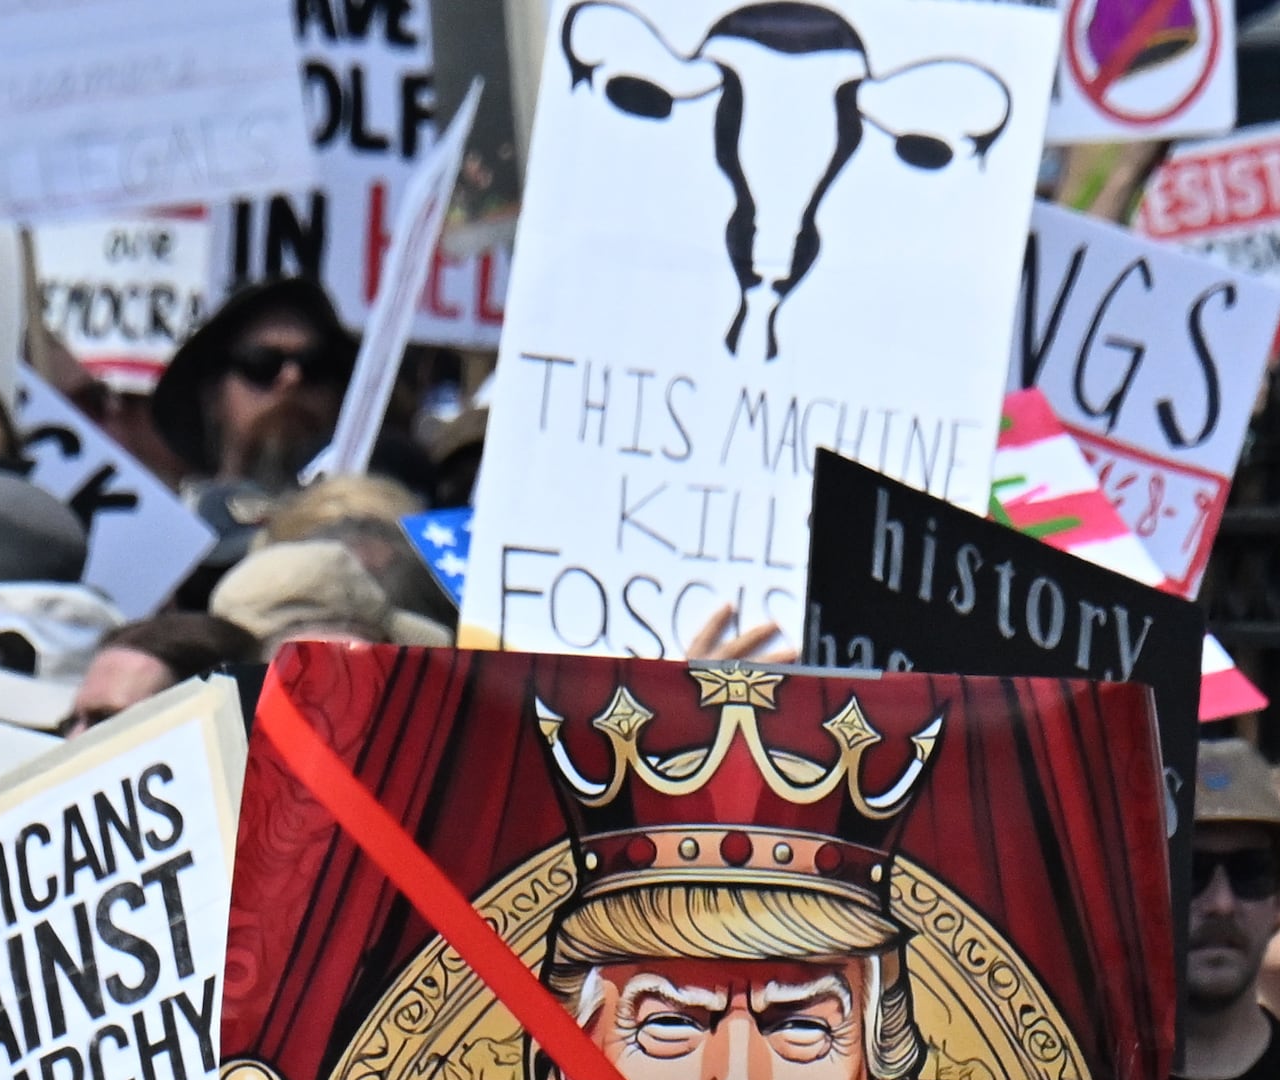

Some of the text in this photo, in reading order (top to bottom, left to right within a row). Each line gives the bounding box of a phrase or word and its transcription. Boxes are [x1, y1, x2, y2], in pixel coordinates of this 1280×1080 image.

[232, 188, 326, 292] IN
[520, 352, 697, 464] THIS
[720, 386, 982, 502] MACHINE
[618, 474, 815, 570] KILL
[870, 486, 1154, 682] history
